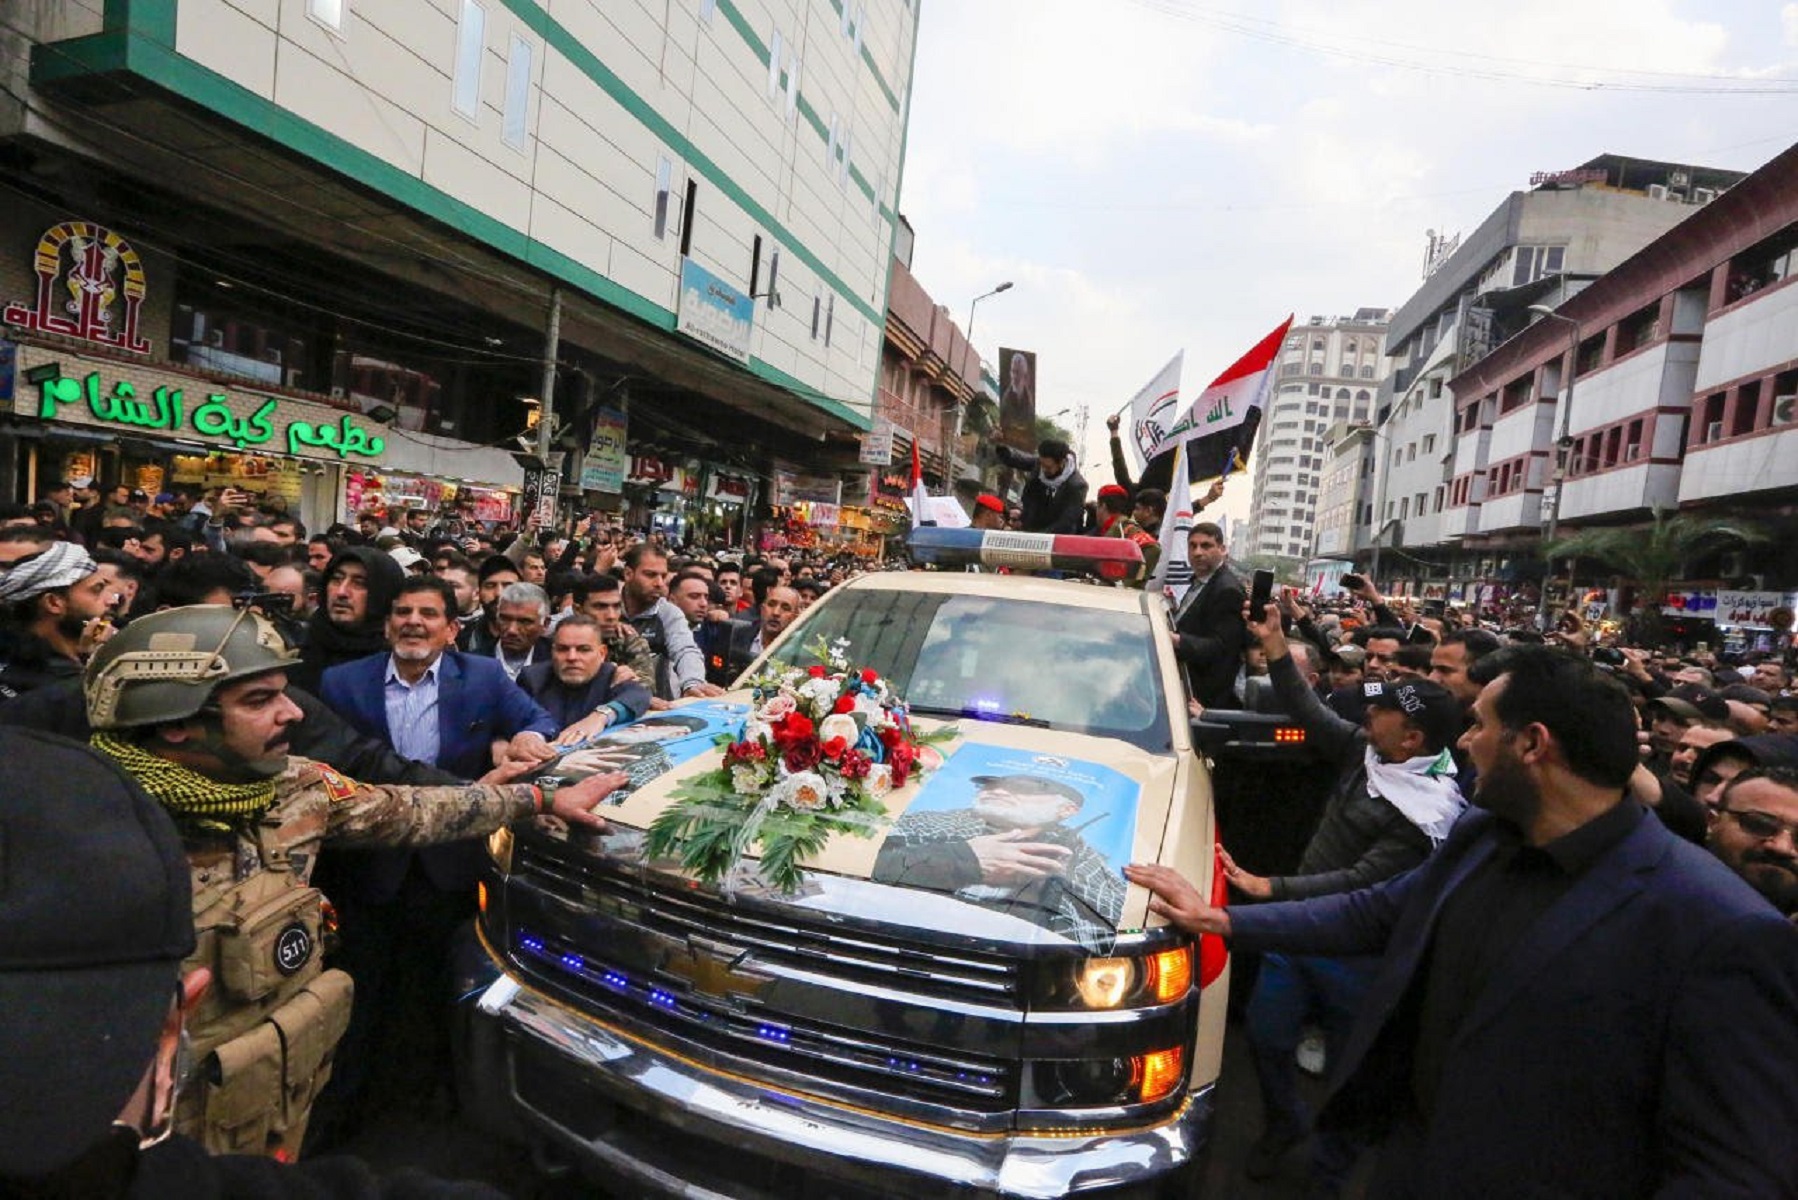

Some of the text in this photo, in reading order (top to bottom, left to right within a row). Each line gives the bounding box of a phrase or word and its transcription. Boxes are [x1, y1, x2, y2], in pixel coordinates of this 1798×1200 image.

[41, 374, 385, 459] مطعم كبة الشام
[1205, 395, 1233, 424] الله
[283, 938, 306, 961] 5.11
